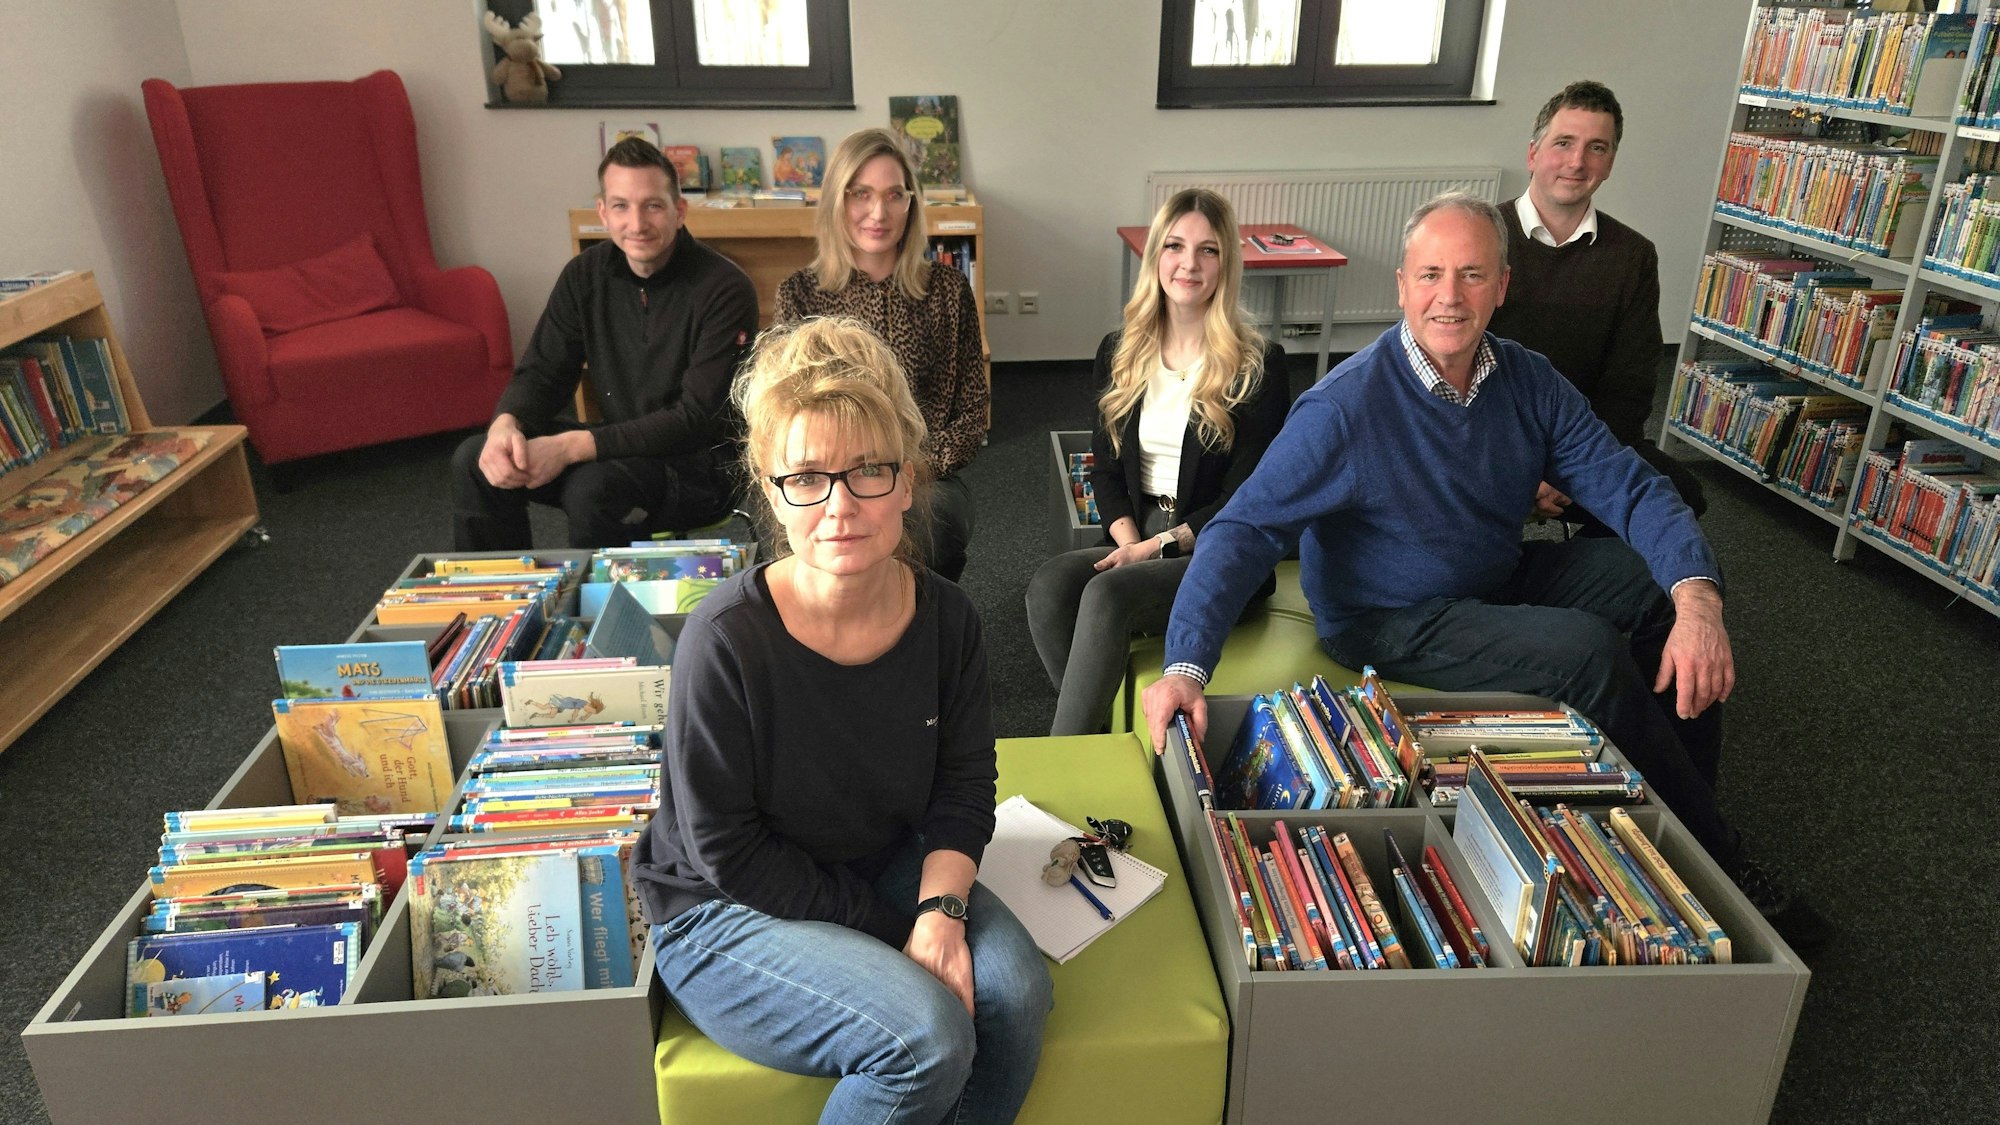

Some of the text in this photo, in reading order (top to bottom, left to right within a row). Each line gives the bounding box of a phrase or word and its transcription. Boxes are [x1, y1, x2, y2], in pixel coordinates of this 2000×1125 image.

[336, 661, 382, 678] MATS
[653, 679, 665, 699] Wir
[379, 753, 396, 789] und ich
[394, 759, 411, 803] der Hund
[406, 756, 418, 780] Gott,
[545, 915, 560, 942] Leb
[589, 892, 615, 988] Wer fliegt mi
[529, 956, 546, 993] Dach
